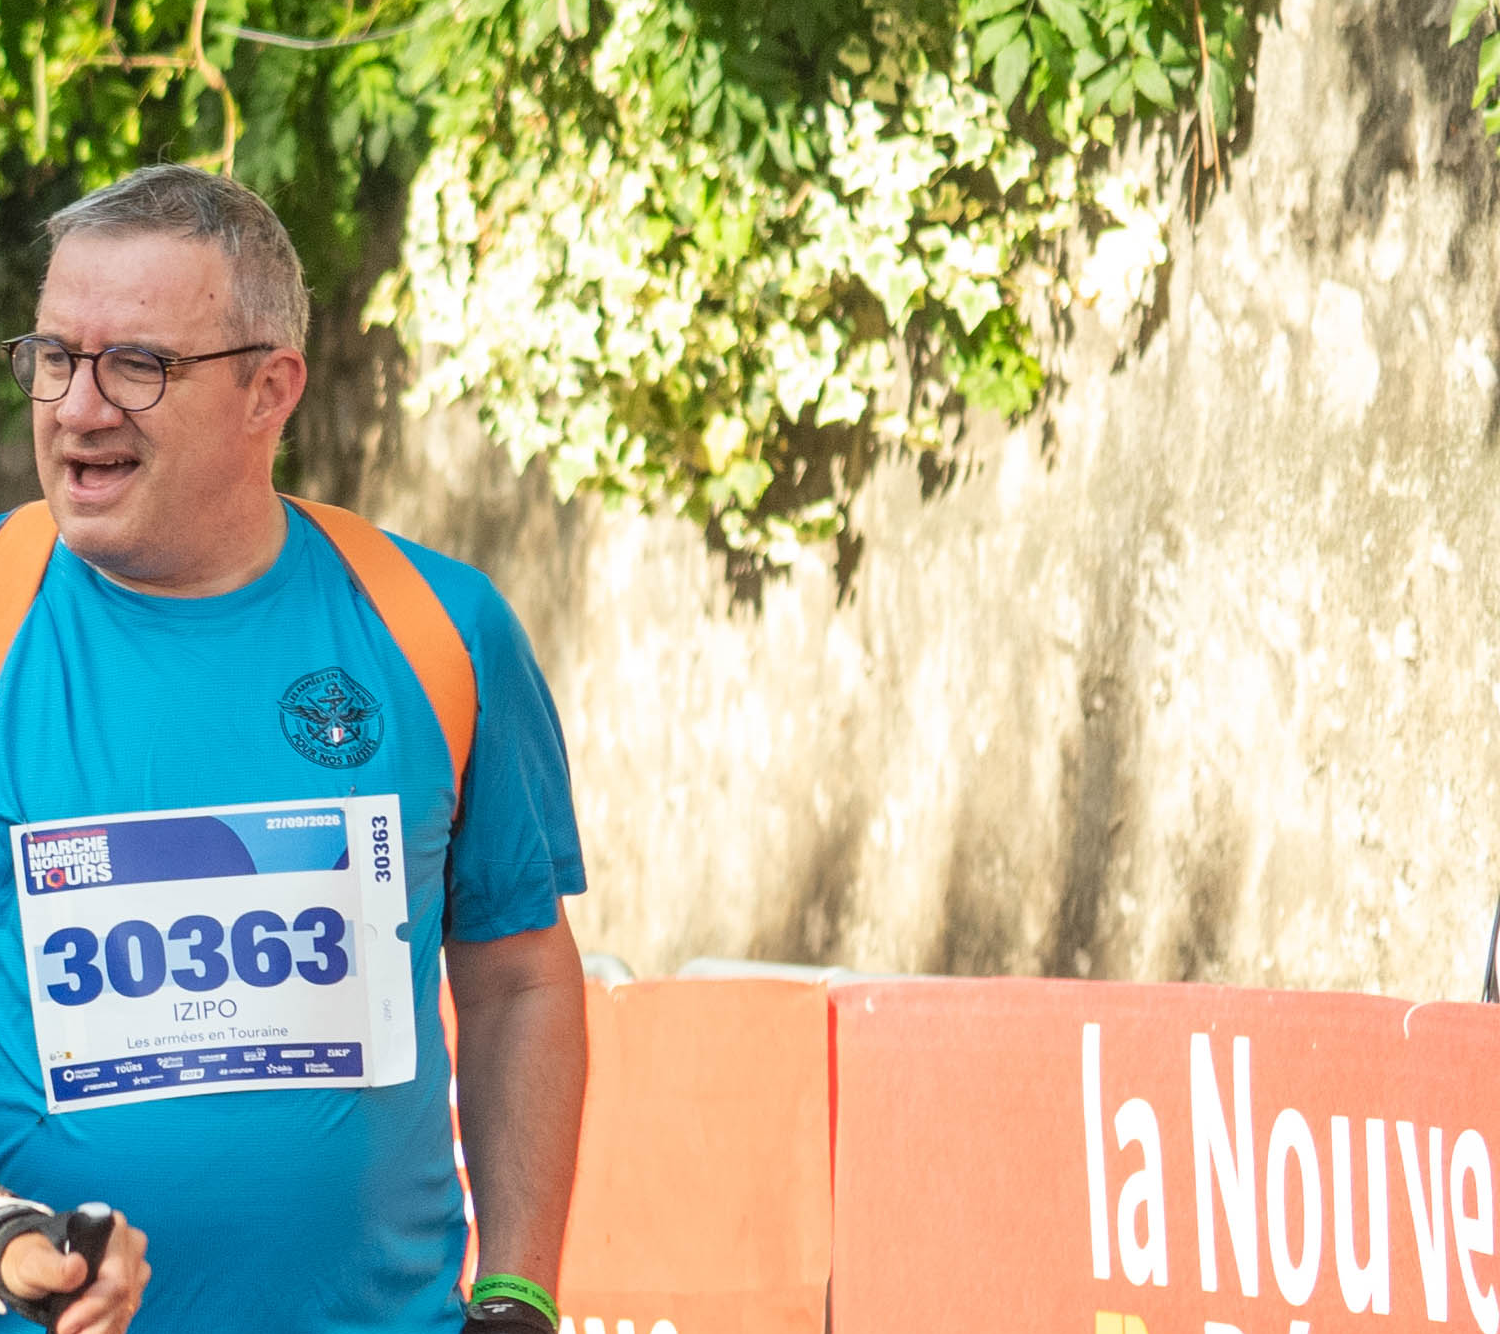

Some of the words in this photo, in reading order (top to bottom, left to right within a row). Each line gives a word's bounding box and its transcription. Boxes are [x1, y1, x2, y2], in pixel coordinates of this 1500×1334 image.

[320, 753, 343, 765] NOS
[28, 835, 109, 858] MARCHE
[29, 850, 109, 868] NORDIQUE
[372, 815, 392, 883] 30363
[32, 861, 113, 891] TOURS
[42, 906, 350, 1006] 30363
[173, 997, 238, 1022] IZIPO
[126, 1036, 151, 1050] Les
[154, 1029, 205, 1047] armées
[208, 1030, 226, 1043] en
[229, 1025, 290, 1042] Touraine
[1082, 1022, 1169, 1287] la
